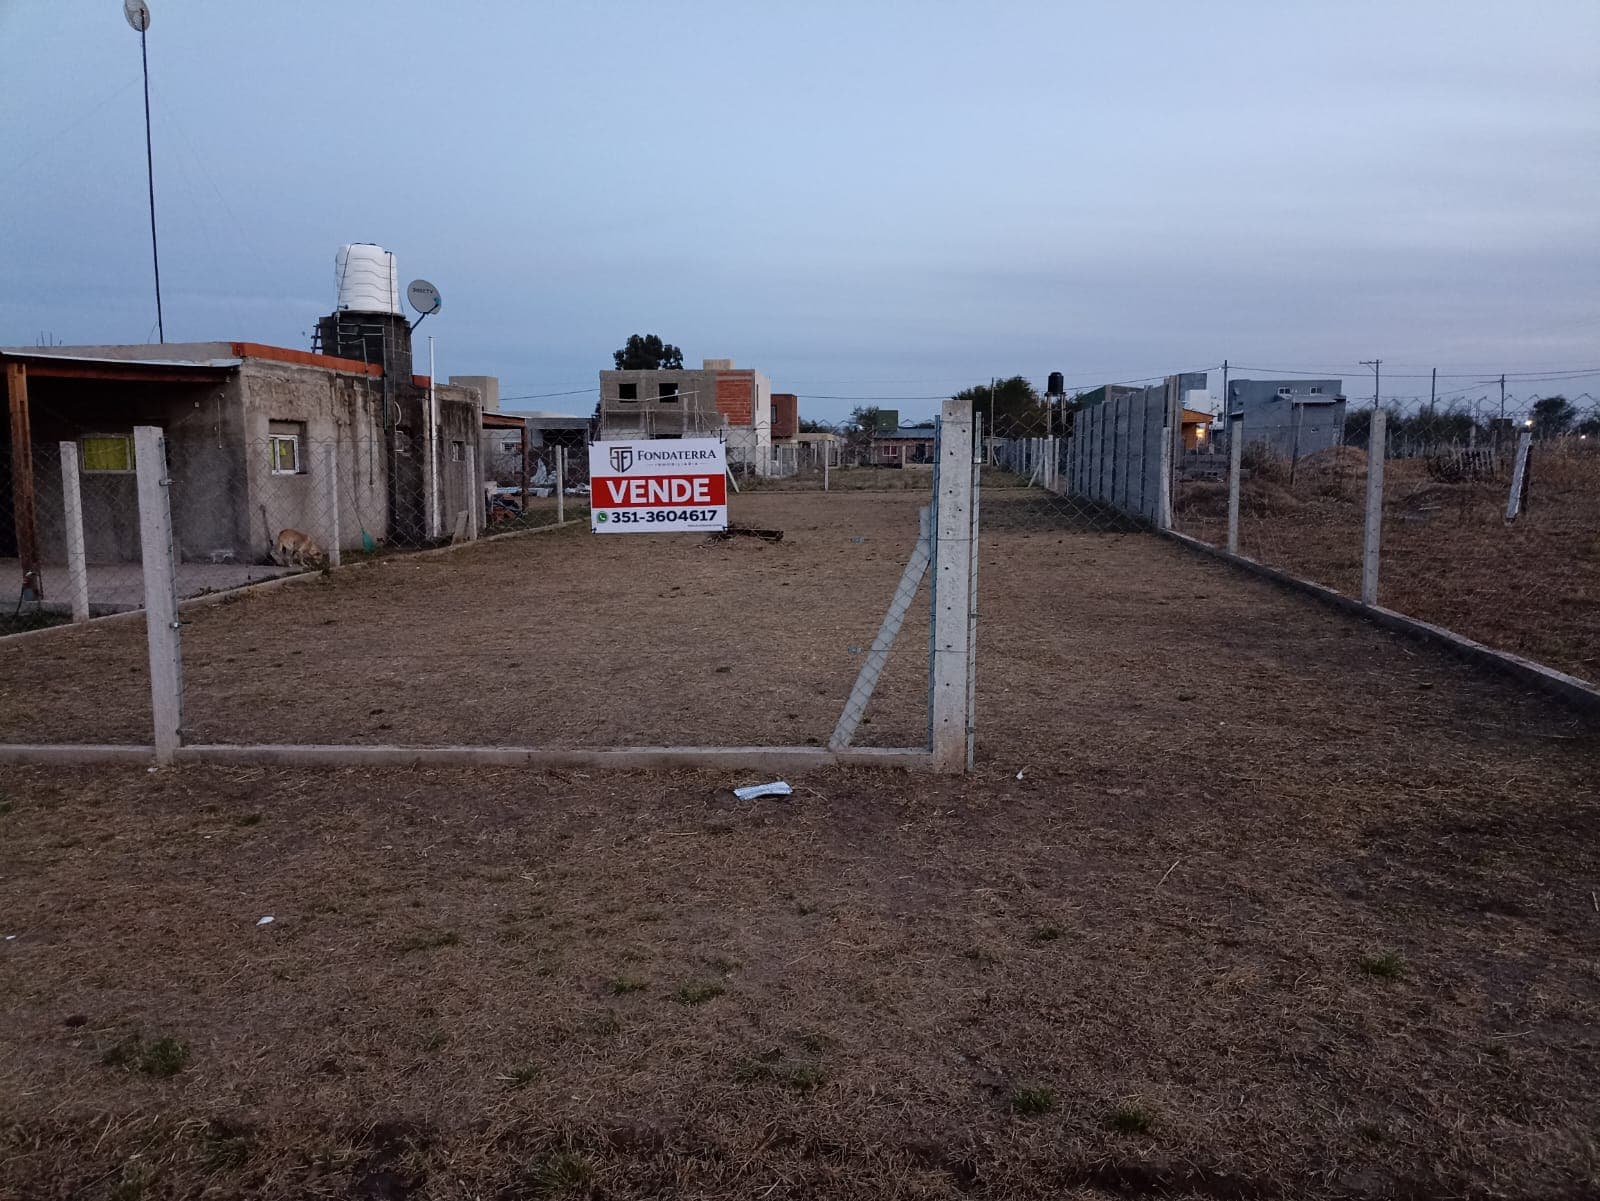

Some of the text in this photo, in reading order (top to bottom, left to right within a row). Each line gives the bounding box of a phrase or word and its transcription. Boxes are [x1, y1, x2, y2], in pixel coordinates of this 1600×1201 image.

[637, 450, 716, 460] FONDATERRA
[606, 478, 711, 504] VENDE
[611, 510, 717, 523] 351-3604617
